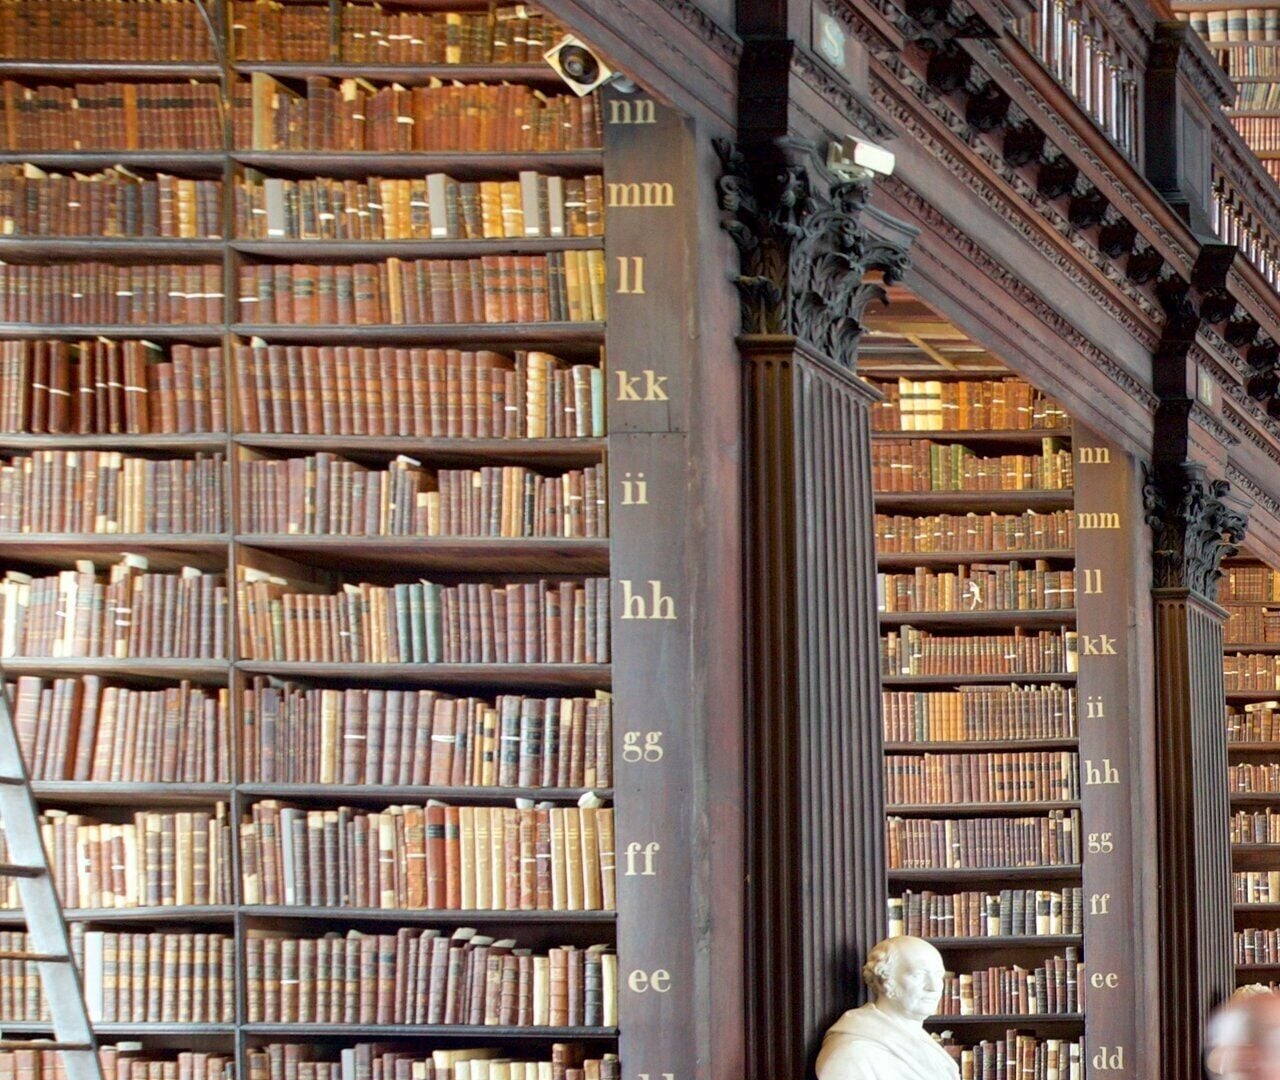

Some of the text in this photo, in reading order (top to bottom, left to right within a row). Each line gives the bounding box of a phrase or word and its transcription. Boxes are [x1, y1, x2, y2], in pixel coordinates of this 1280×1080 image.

[610, 100, 656, 124] nn
[608, 182, 674, 206] mm
[616, 257, 644, 294] ll
[616, 370, 669, 401] kk
[1079, 448, 1110, 464] nn
[621, 472, 648, 504] ii
[1078, 512, 1120, 528] mm
[1084, 569, 1103, 594] ll
[619, 580, 677, 620] hh
[1082, 635, 1116, 655] kk
[1087, 696, 1104, 718] ii
[623, 732, 663, 762] gg
[1084, 760, 1120, 785] hh
[1088, 832, 1113, 852] gg
[624, 841, 660, 876] ff
[1090, 894, 1110, 914] ff
[628, 968, 671, 993] ee
[1091, 972, 1118, 988] ee
[1093, 1046, 1124, 1070] dd
